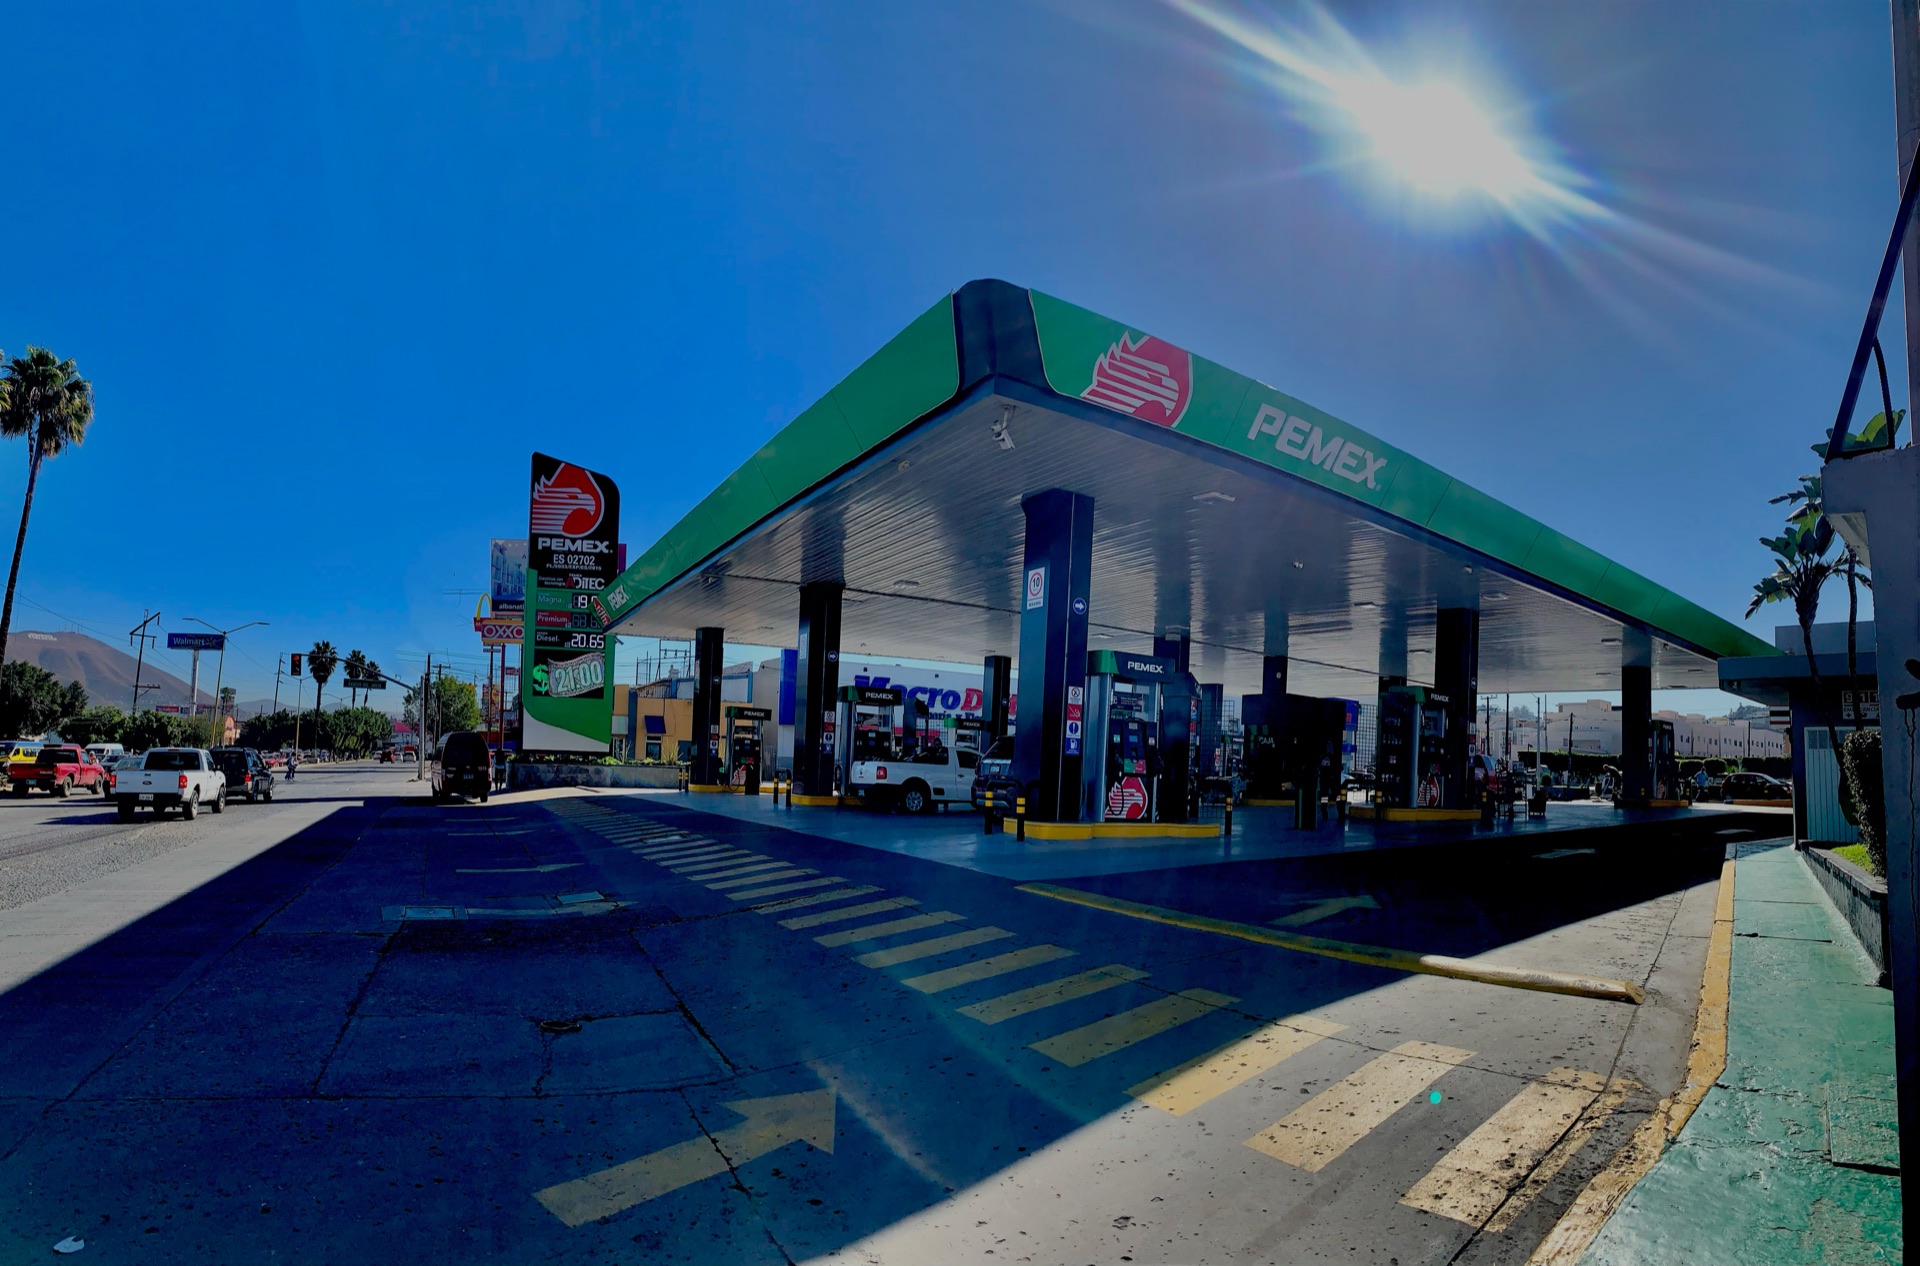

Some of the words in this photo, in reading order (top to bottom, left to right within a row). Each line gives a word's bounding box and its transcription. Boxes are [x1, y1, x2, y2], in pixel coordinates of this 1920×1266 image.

[1247, 402, 1387, 490] PEMEX
[537, 537, 610, 554] PEMEX
[552, 553, 565, 564] ES
[567, 554, 595, 566] 02702
[1032, 576, 1041, 588] 10
[538, 595, 562, 604] Magna
[537, 614, 568, 623] Premium
[483, 624, 525, 640] OXXO
[173, 637, 205, 646] Walmart
[536, 634, 558, 643] Diesel
[571, 633, 604, 649] 20.65
[1127, 661, 1165, 675] PEMEX
[865, 691, 895, 700] PEMEX
